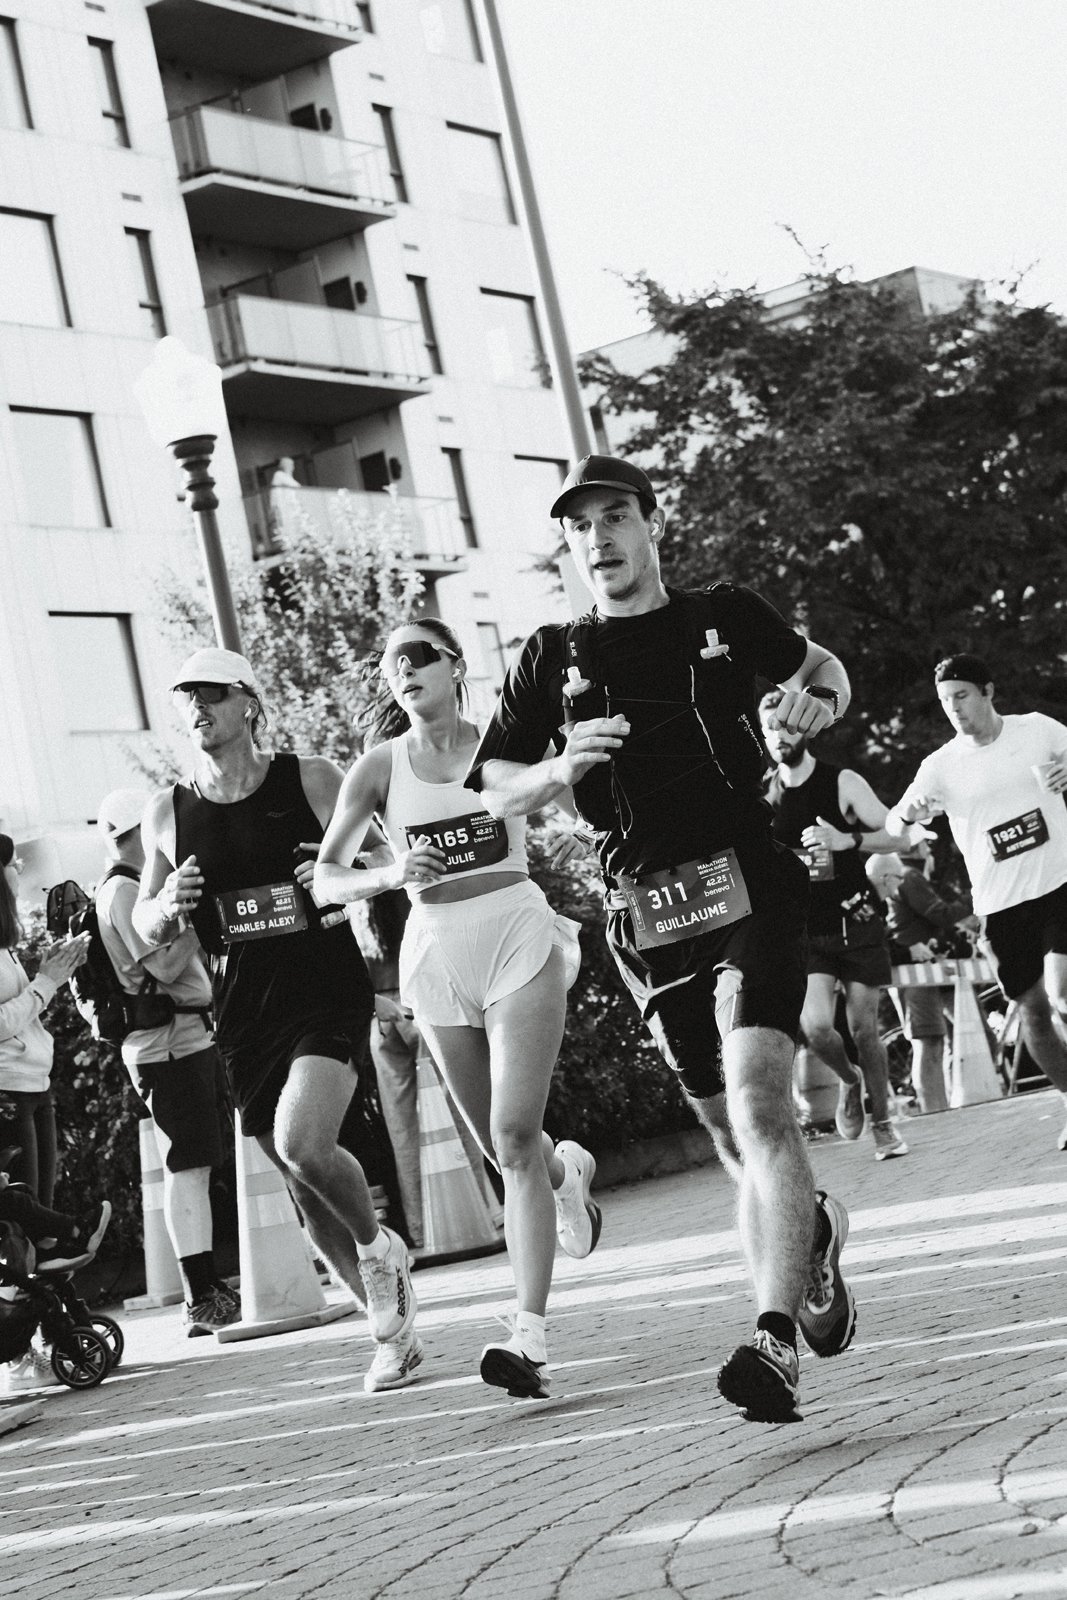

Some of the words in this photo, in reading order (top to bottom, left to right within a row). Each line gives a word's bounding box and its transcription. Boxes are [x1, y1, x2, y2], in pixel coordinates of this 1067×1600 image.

[470, 814, 492, 823] MARATHO
[993, 824, 1024, 844] 1921
[446, 851, 476, 866] JULIE
[647, 882, 688, 910] 311
[703, 884, 730, 897] beneva
[236, 899, 258, 916] 66
[228, 920, 266, 934] CHARLES
[268, 914, 296, 929] ALEXY
[655, 901, 728, 933] GUILLAUME
